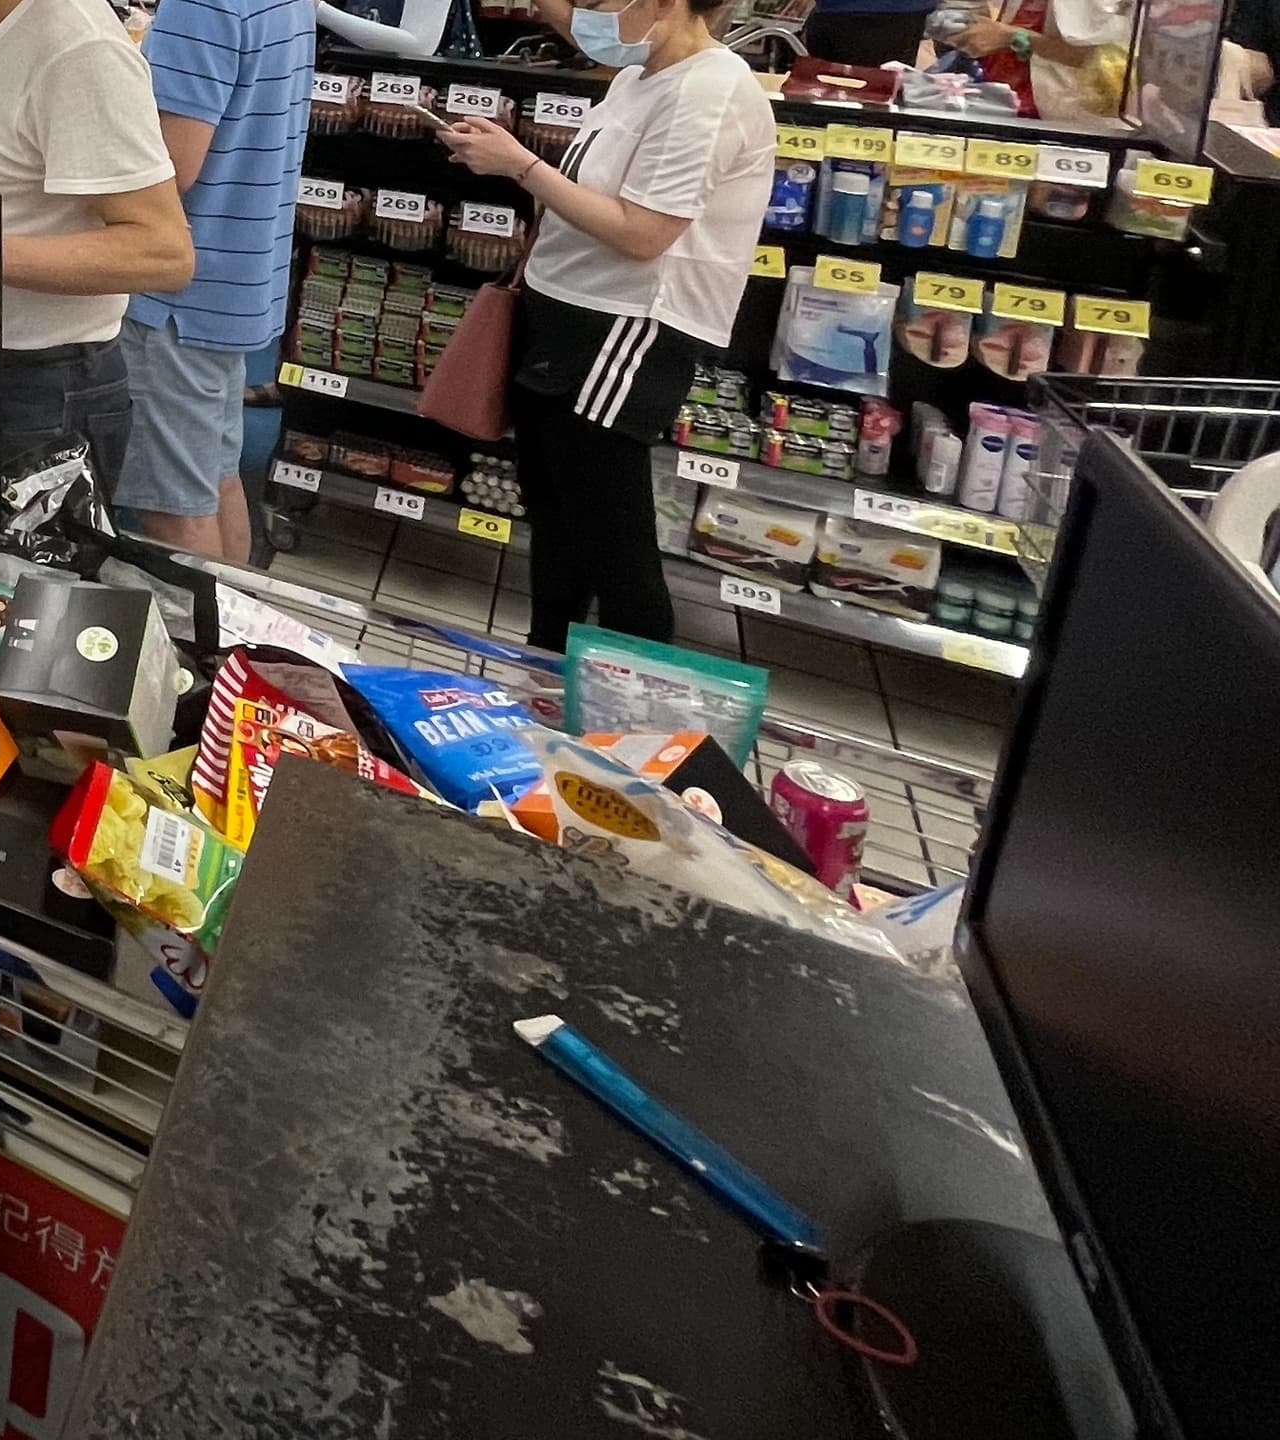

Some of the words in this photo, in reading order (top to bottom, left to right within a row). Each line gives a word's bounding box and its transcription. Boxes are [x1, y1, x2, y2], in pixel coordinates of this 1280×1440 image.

[376, 79, 415, 98] 269
[453, 91, 494, 110] 269
[541, 100, 584, 119] 269
[851, 136, 887, 153] 199
[918, 142, 956, 160] 79
[995, 150, 1032, 169] 89
[1055, 157, 1093, 175] 69
[1153, 172, 1194, 190] 69
[302, 185, 339, 201] 269
[382, 195, 420, 213] 269
[468, 209, 510, 228] 269
[831, 267, 867, 284] 65
[929, 283, 968, 301] 79
[1009, 294, 1047, 313] 79
[1092, 306, 1132, 325] 79
[307, 374, 342, 390] 119
[470, 516, 500, 534] 70
[726, 582, 773, 603] 399
[414, 709, 483, 746] BEAN
